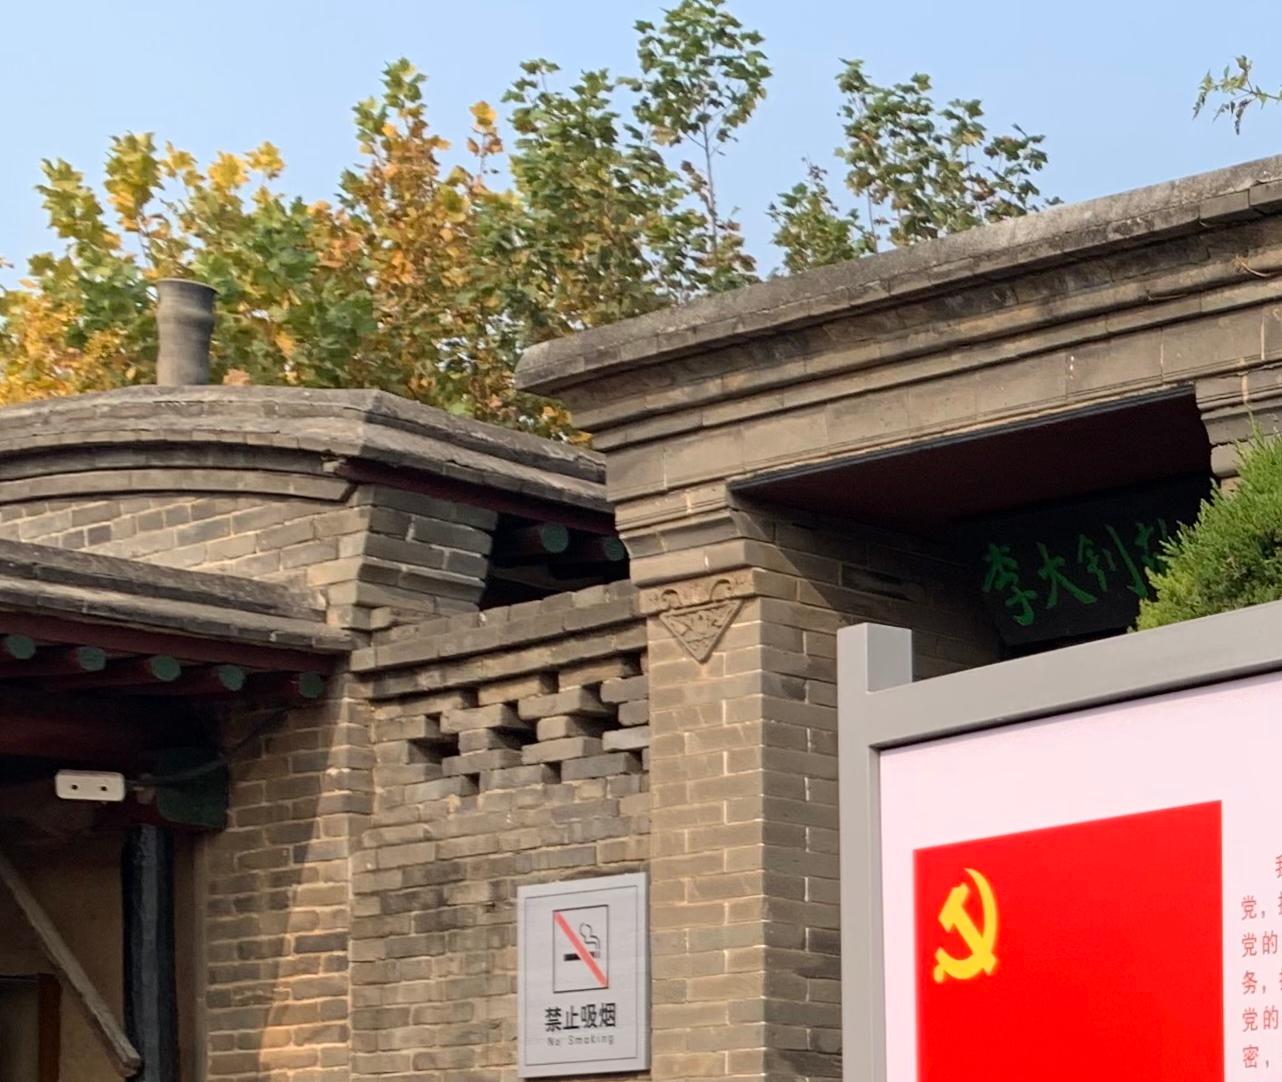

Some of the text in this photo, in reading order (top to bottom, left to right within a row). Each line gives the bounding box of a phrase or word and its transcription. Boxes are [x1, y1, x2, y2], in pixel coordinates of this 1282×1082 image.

[545, 1002, 615, 1032] 禁止吸烟
[547, 1035, 614, 1046] No Smoking
